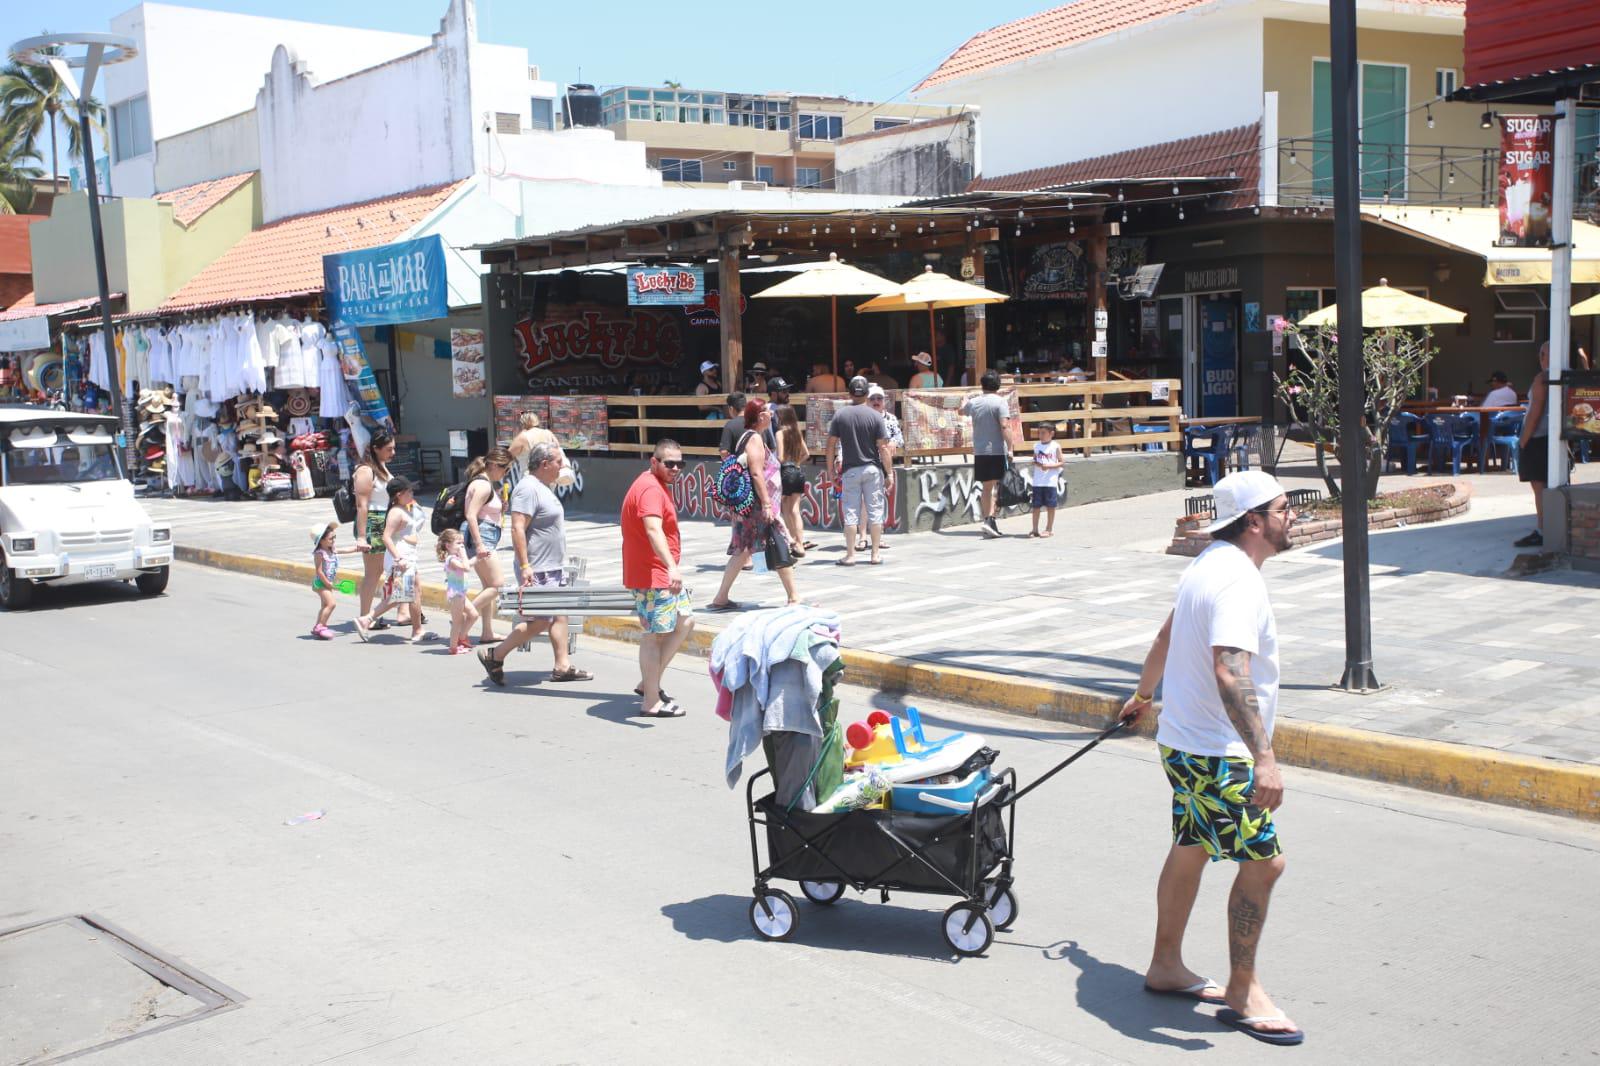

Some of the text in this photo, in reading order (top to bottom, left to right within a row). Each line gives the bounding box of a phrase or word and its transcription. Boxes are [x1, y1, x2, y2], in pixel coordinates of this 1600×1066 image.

[1506, 118, 1552, 133] SUGAR
[1505, 150, 1551, 165] SUGAR
[389, 251, 428, 296] MAR
[528, 374, 618, 389] CANTINA
[1206, 369, 1236, 383] BUD
